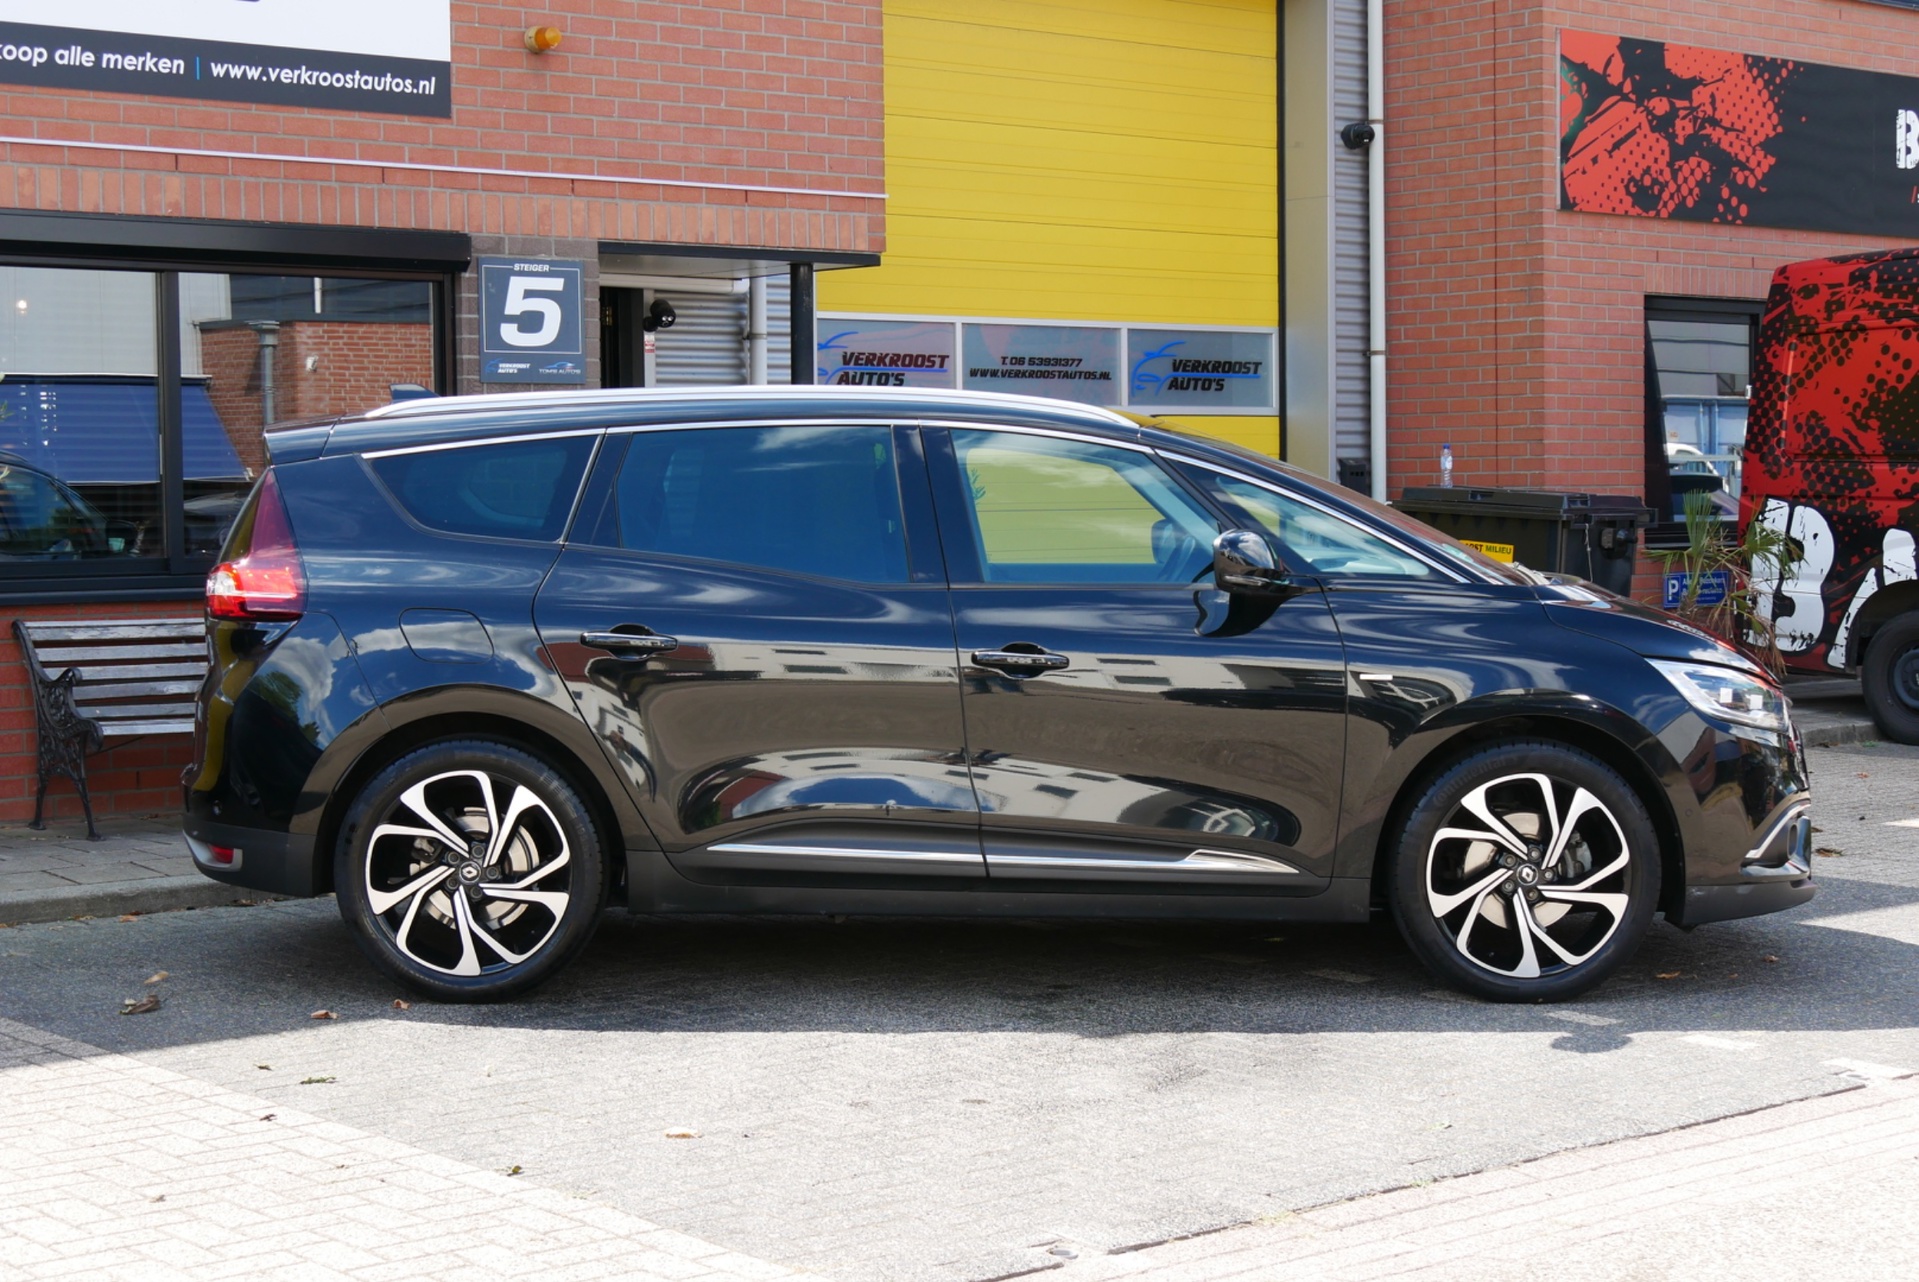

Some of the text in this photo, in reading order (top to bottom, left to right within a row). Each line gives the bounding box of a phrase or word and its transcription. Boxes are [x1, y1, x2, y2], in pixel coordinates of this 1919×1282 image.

[54, 45, 95, 67] alle
[101, 52, 185, 75] merken
[210, 62, 436, 95] www.verkroostautos.nl
[513, 263, 550, 273] STEIGER
[500, 276, 565, 347] 5
[841, 351, 950, 369] VERKROOST
[1009, 356, 1027, 366] 06
[1027, 356, 1083, 368] 53931377
[1171, 359, 1263, 375] VERKROOST
[836, 371, 906, 387] AUTO'S
[969, 367, 1112, 381] WWW.VERKROOSTAUTOS.NL
[1167, 377, 1225, 392] AUTO'S
[1485, 544, 1512, 555] MILIEU
[1668, 579, 1679, 601] P
